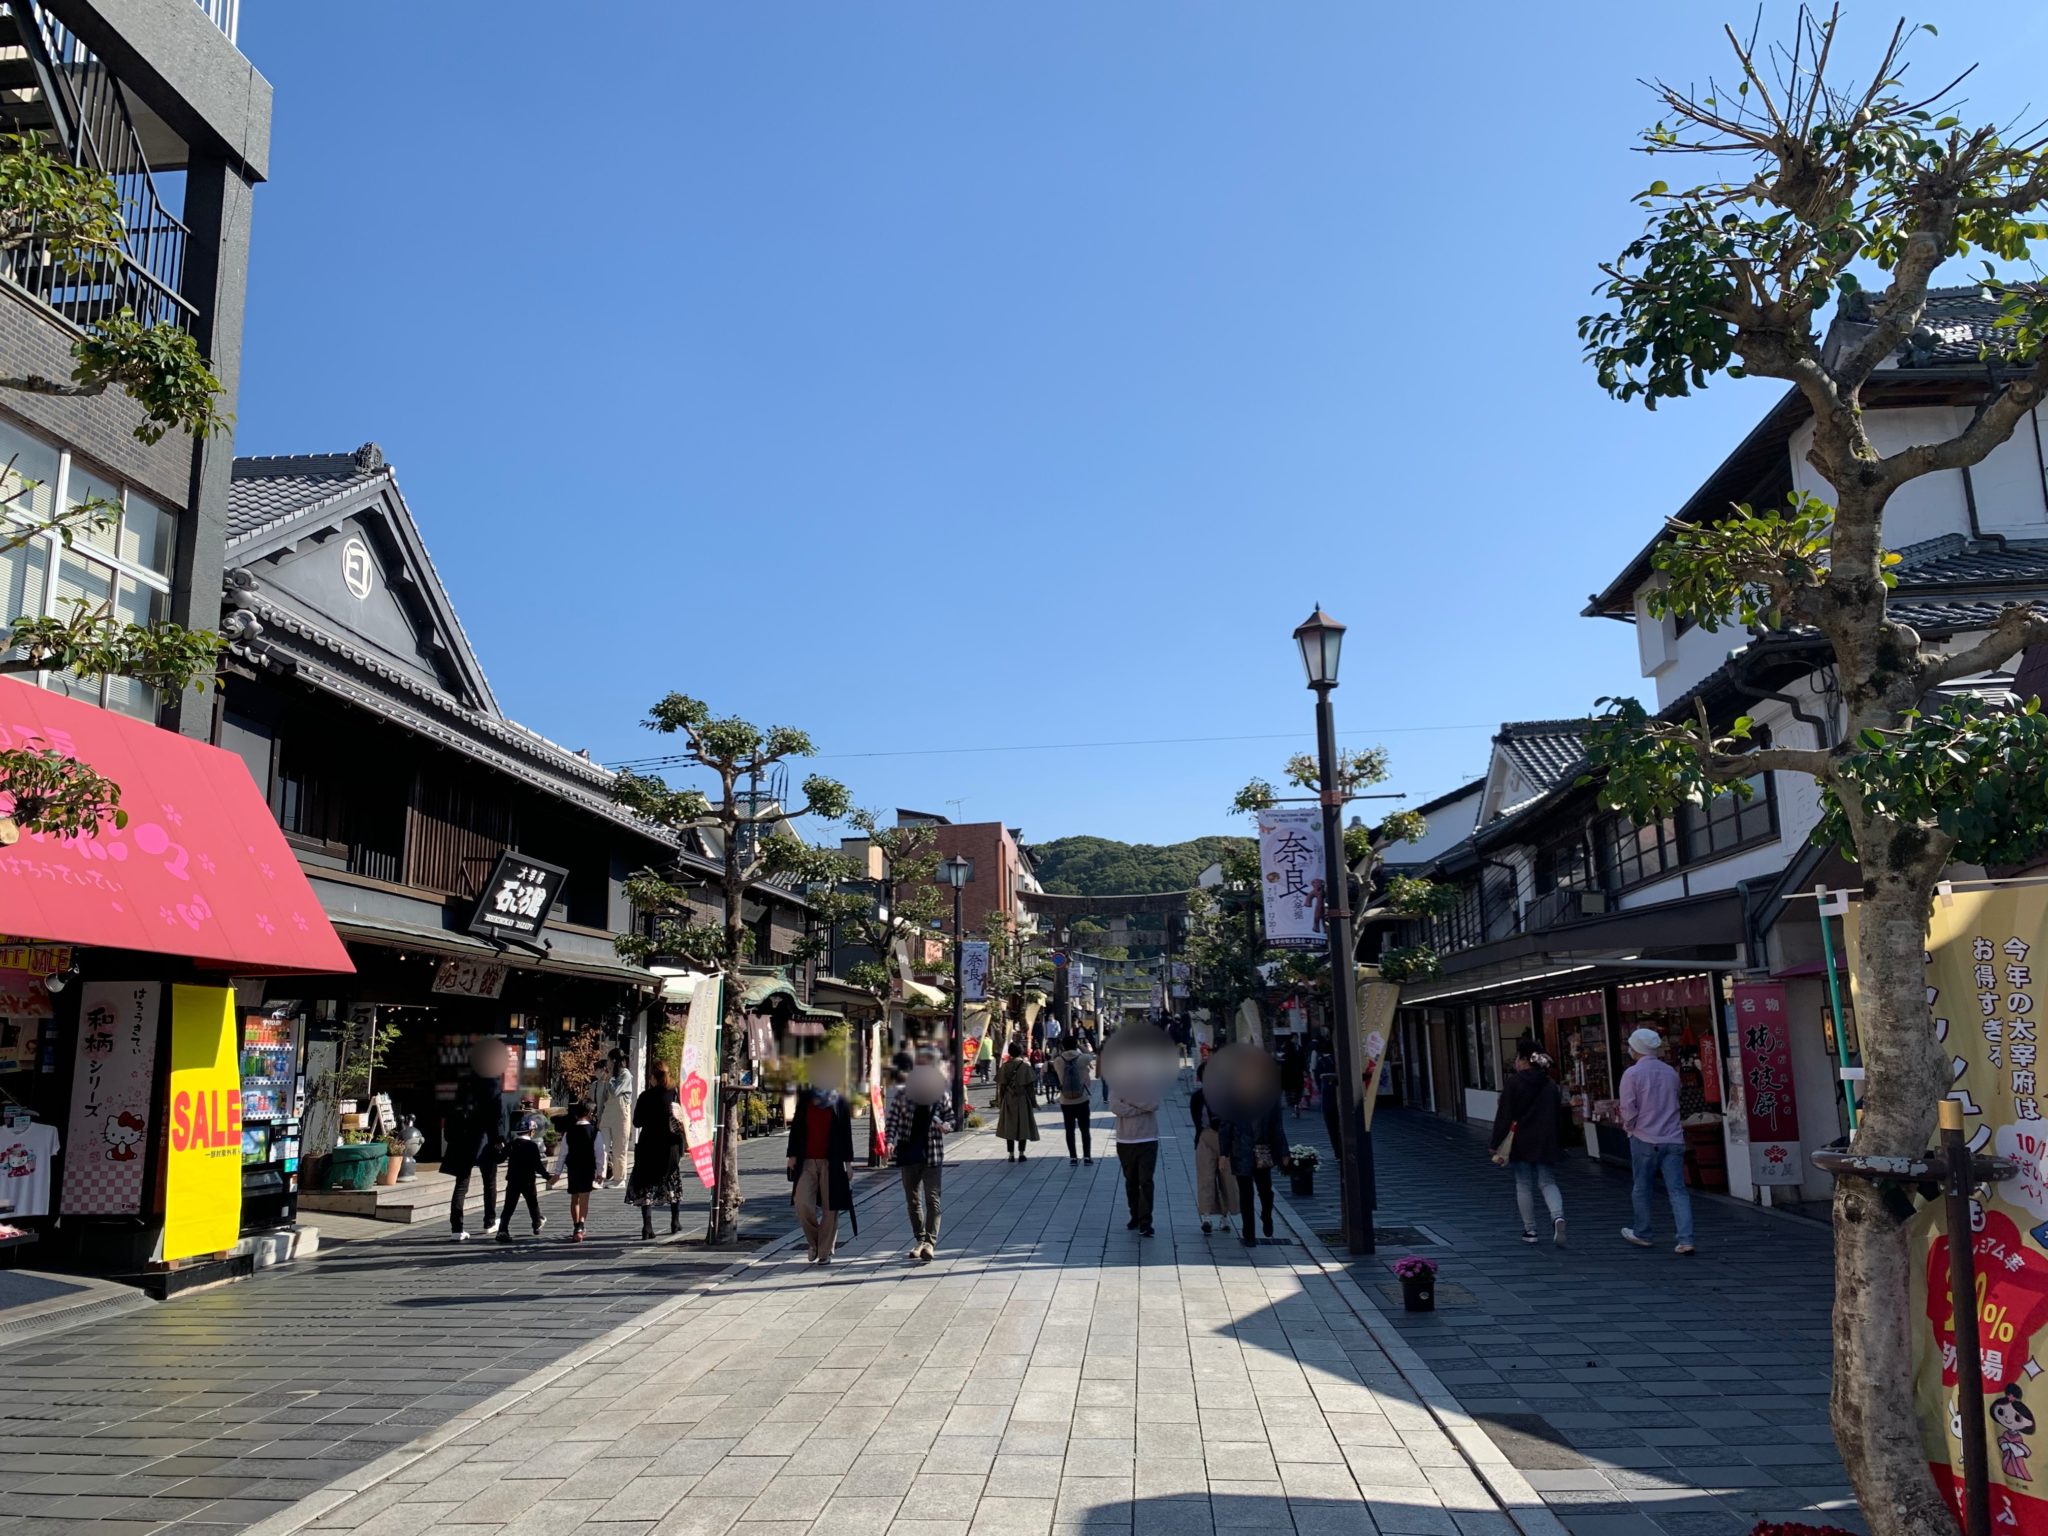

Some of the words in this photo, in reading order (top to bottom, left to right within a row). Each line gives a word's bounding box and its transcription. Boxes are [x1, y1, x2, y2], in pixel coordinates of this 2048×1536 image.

[1273, 831, 1313, 899] 奈良
[1741, 998, 1780, 1012] 名物
[2002, 936, 2042, 1120] 今年の太宰府は
[84, 1006, 115, 1118] 和柄シリーズ
[171, 1089, 241, 1152] SALE
